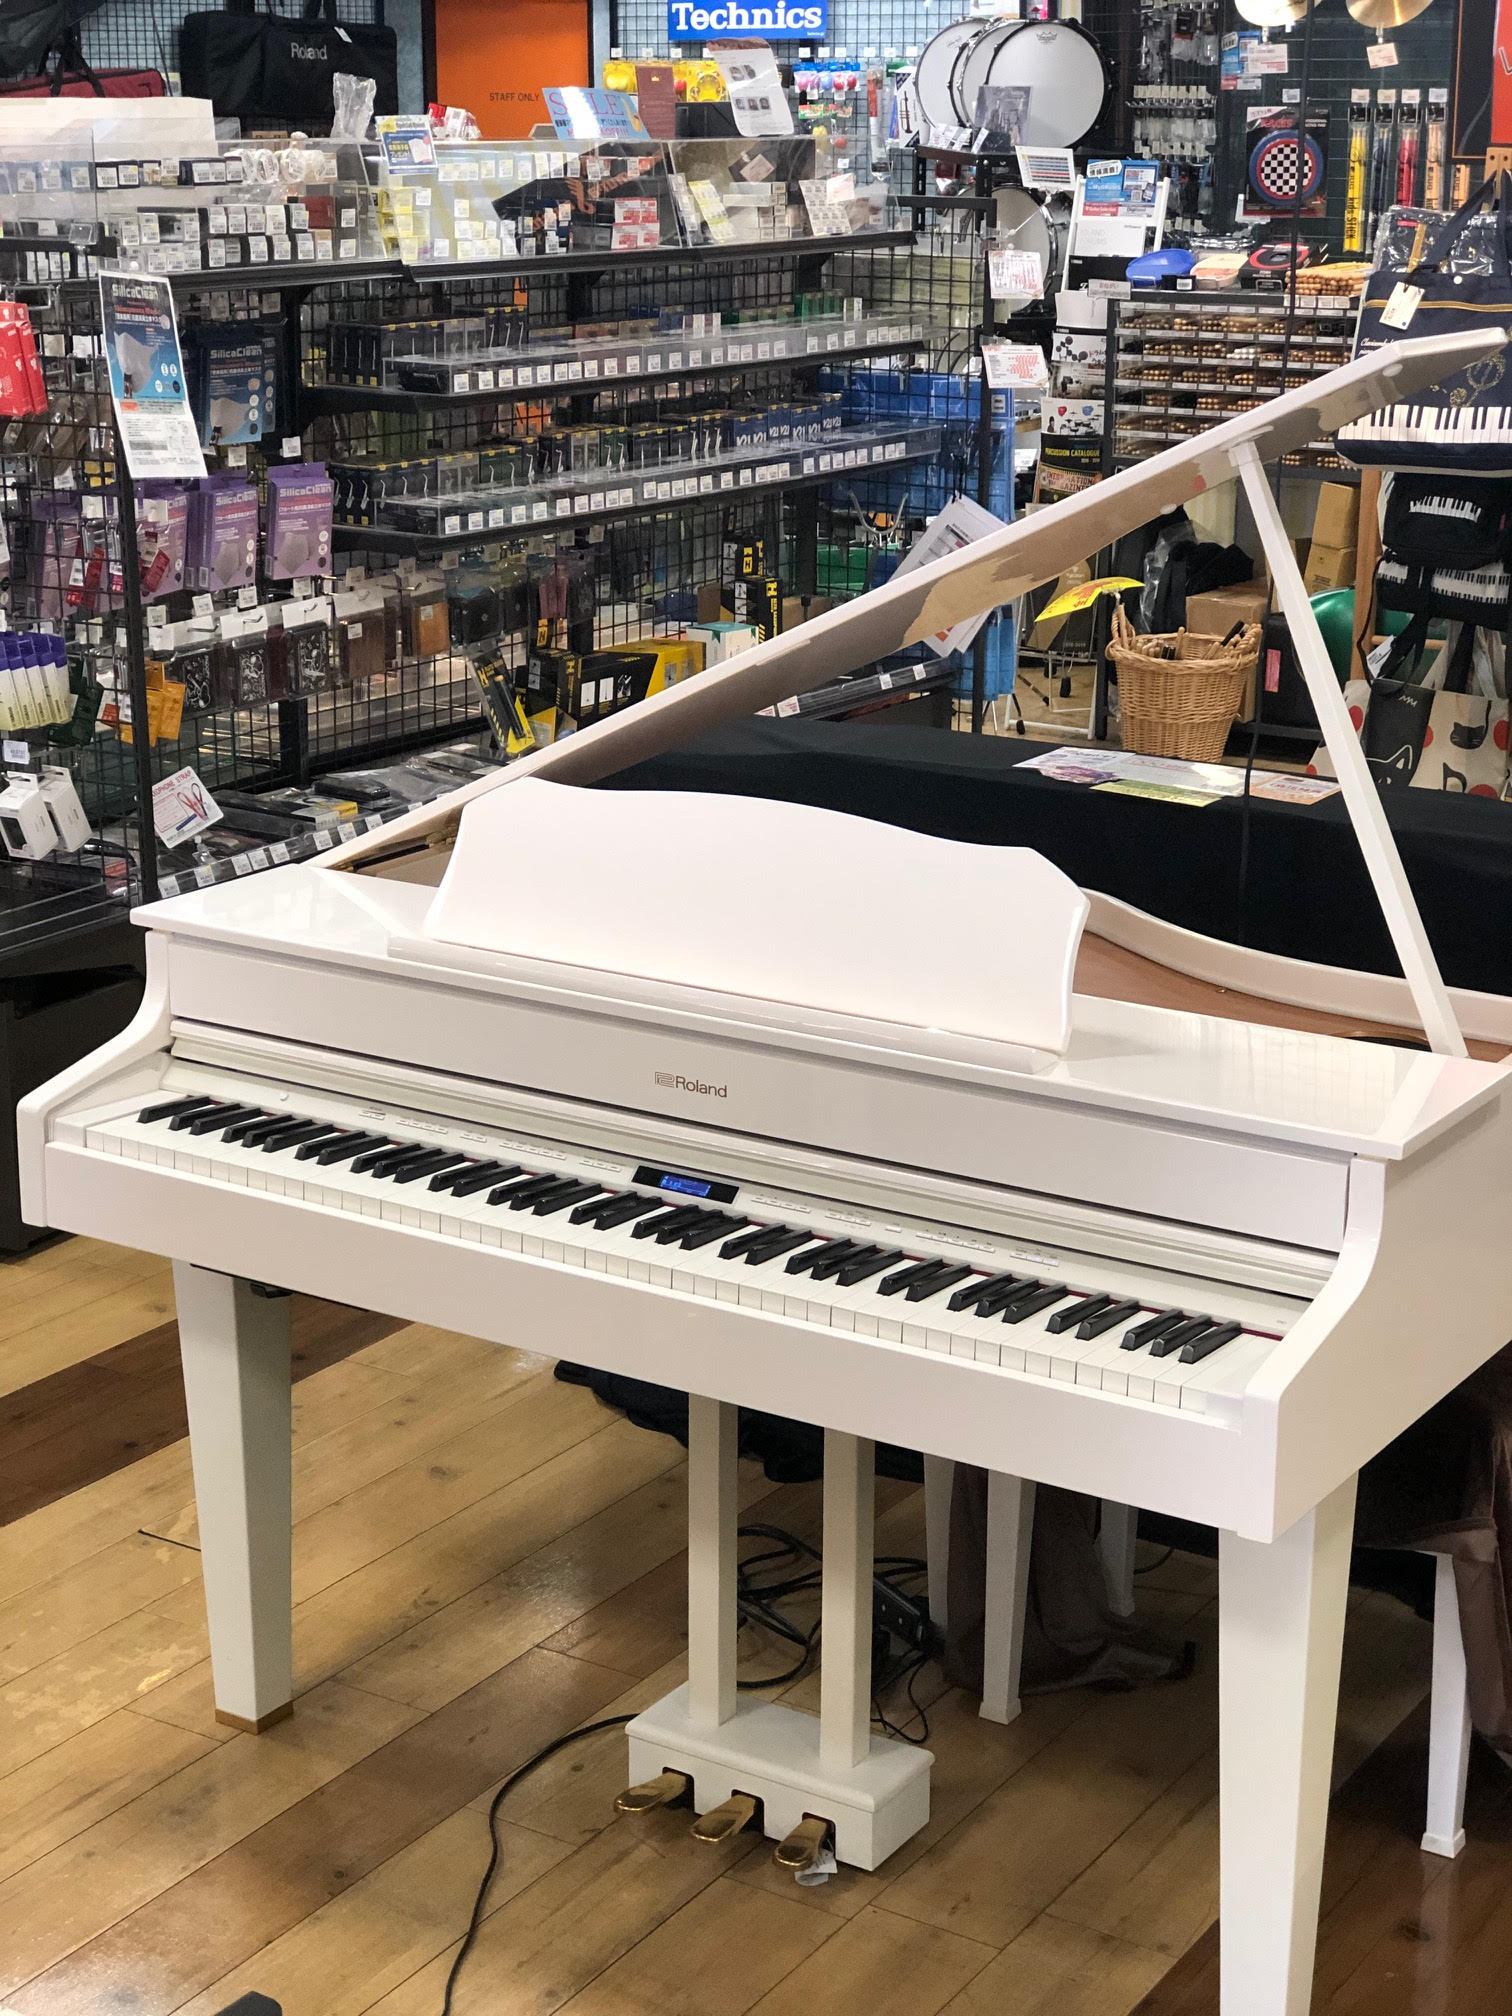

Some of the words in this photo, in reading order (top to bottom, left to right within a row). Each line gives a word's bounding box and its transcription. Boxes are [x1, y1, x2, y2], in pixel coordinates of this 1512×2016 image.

[672, 0, 822, 31] Technics
[290, 43, 328, 61] Roland
[489, 92, 515, 102] STAFF
[517, 92, 539, 102] ONLY
[548, 91, 625, 116] SLE
[210, 346, 263, 360] SilicaClean
[1070, 449, 1100, 457] CATALOGUE
[279, 483, 332, 498] SilicaClean
[675, 1075, 728, 1098] Roland
